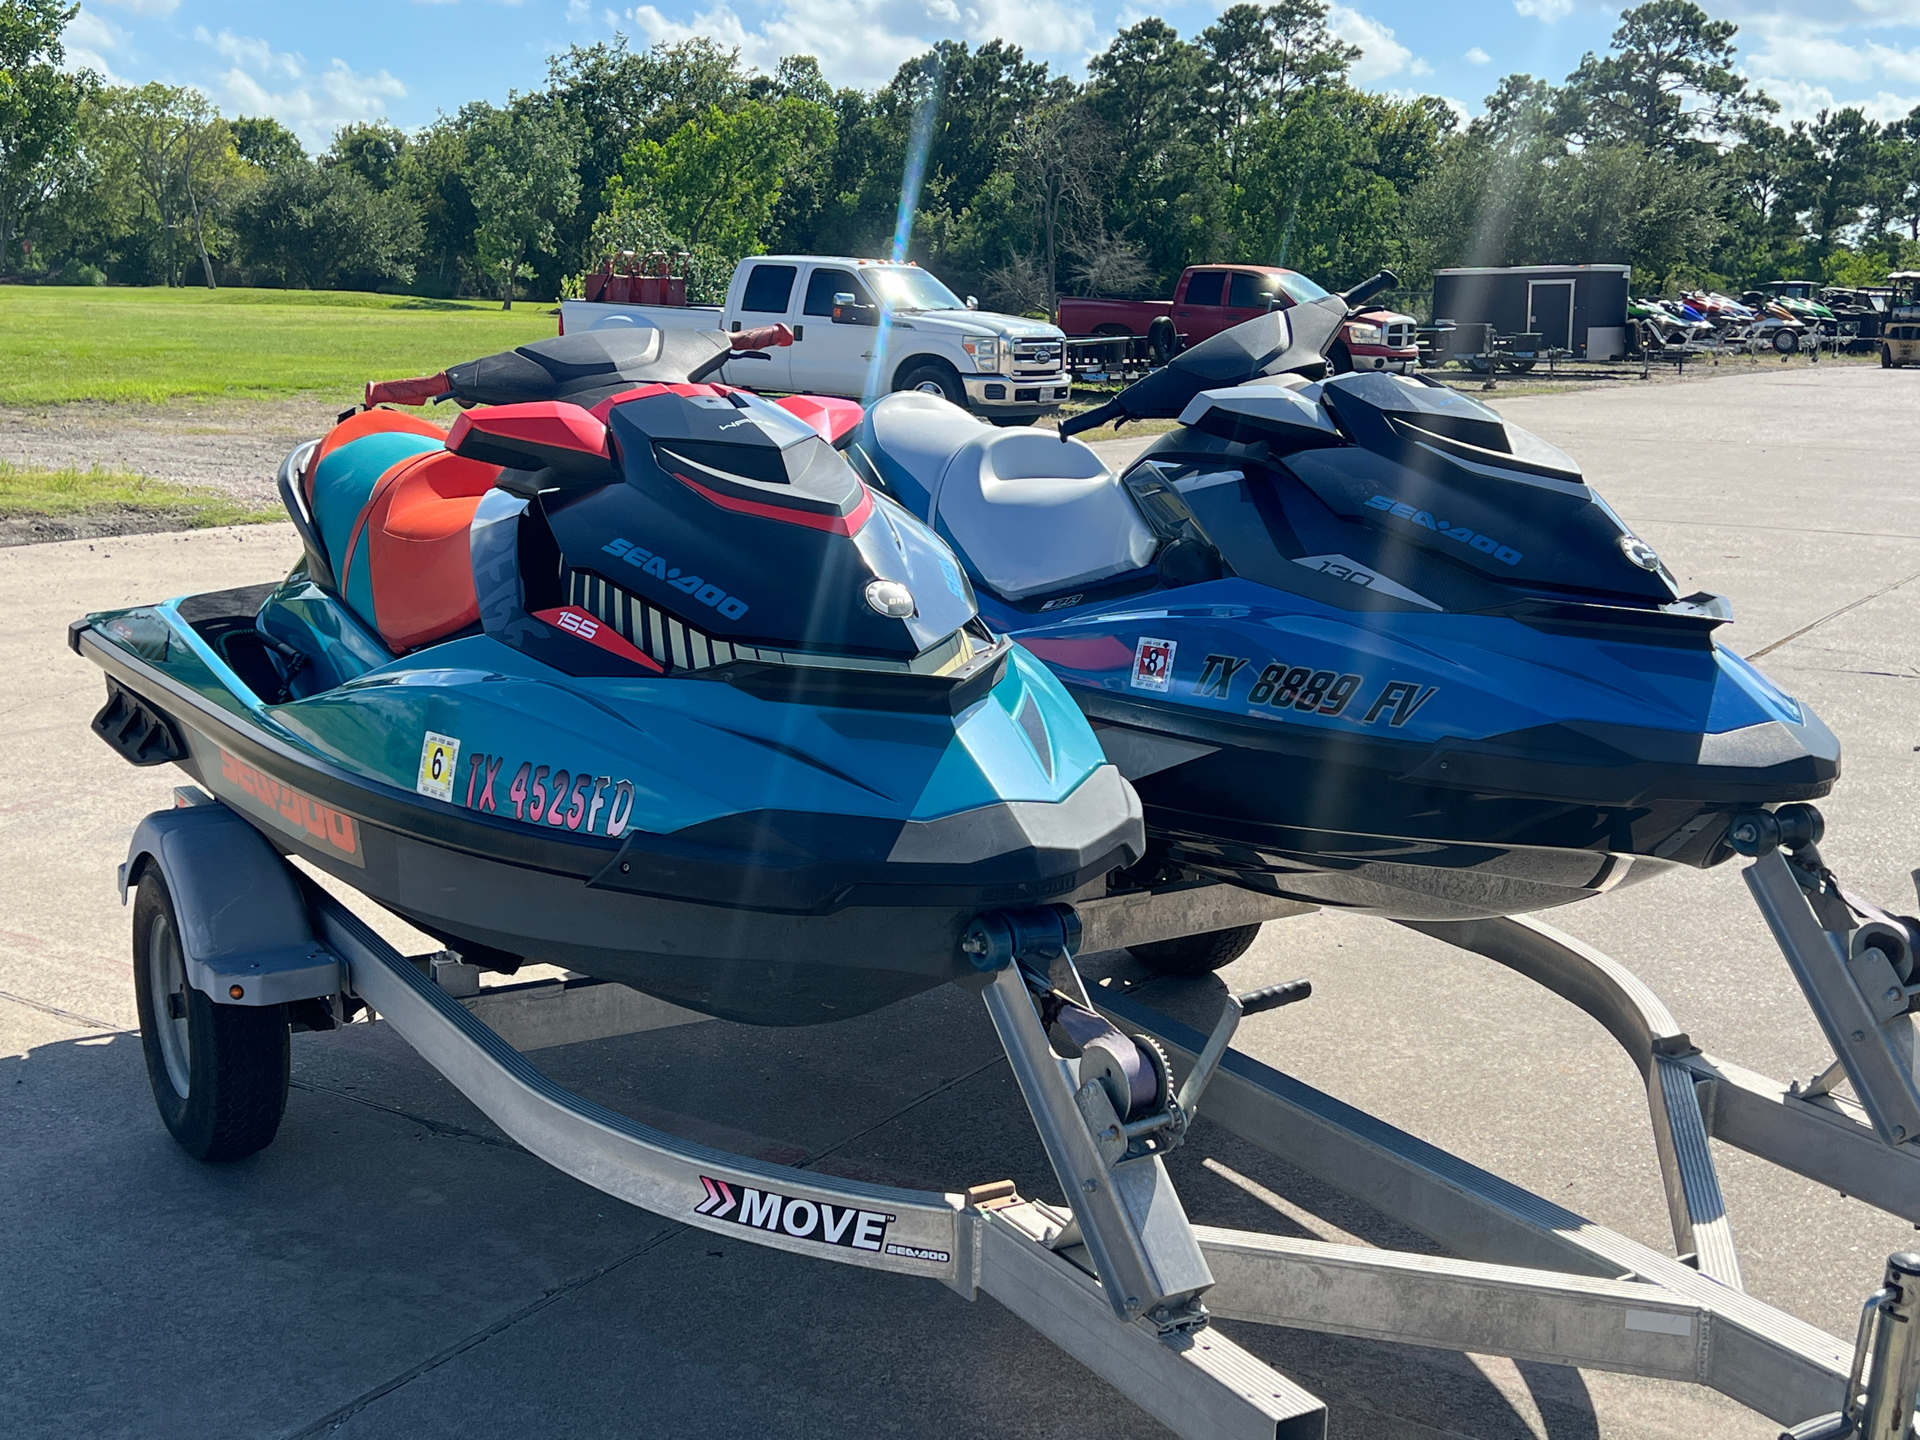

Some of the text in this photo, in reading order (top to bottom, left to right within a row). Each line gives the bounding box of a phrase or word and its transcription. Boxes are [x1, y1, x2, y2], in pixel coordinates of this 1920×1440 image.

[1319, 561, 1375, 587] 130
[557, 611, 599, 639] 155
[1146, 649, 1159, 676] 8
[1192, 654, 1251, 700] TX
[1247, 663, 1364, 717] 8889
[1362, 681, 1440, 729] FV
[432, 747, 444, 780] 6
[466, 753, 503, 813] TX
[738, 1188, 887, 1250] MOVE
